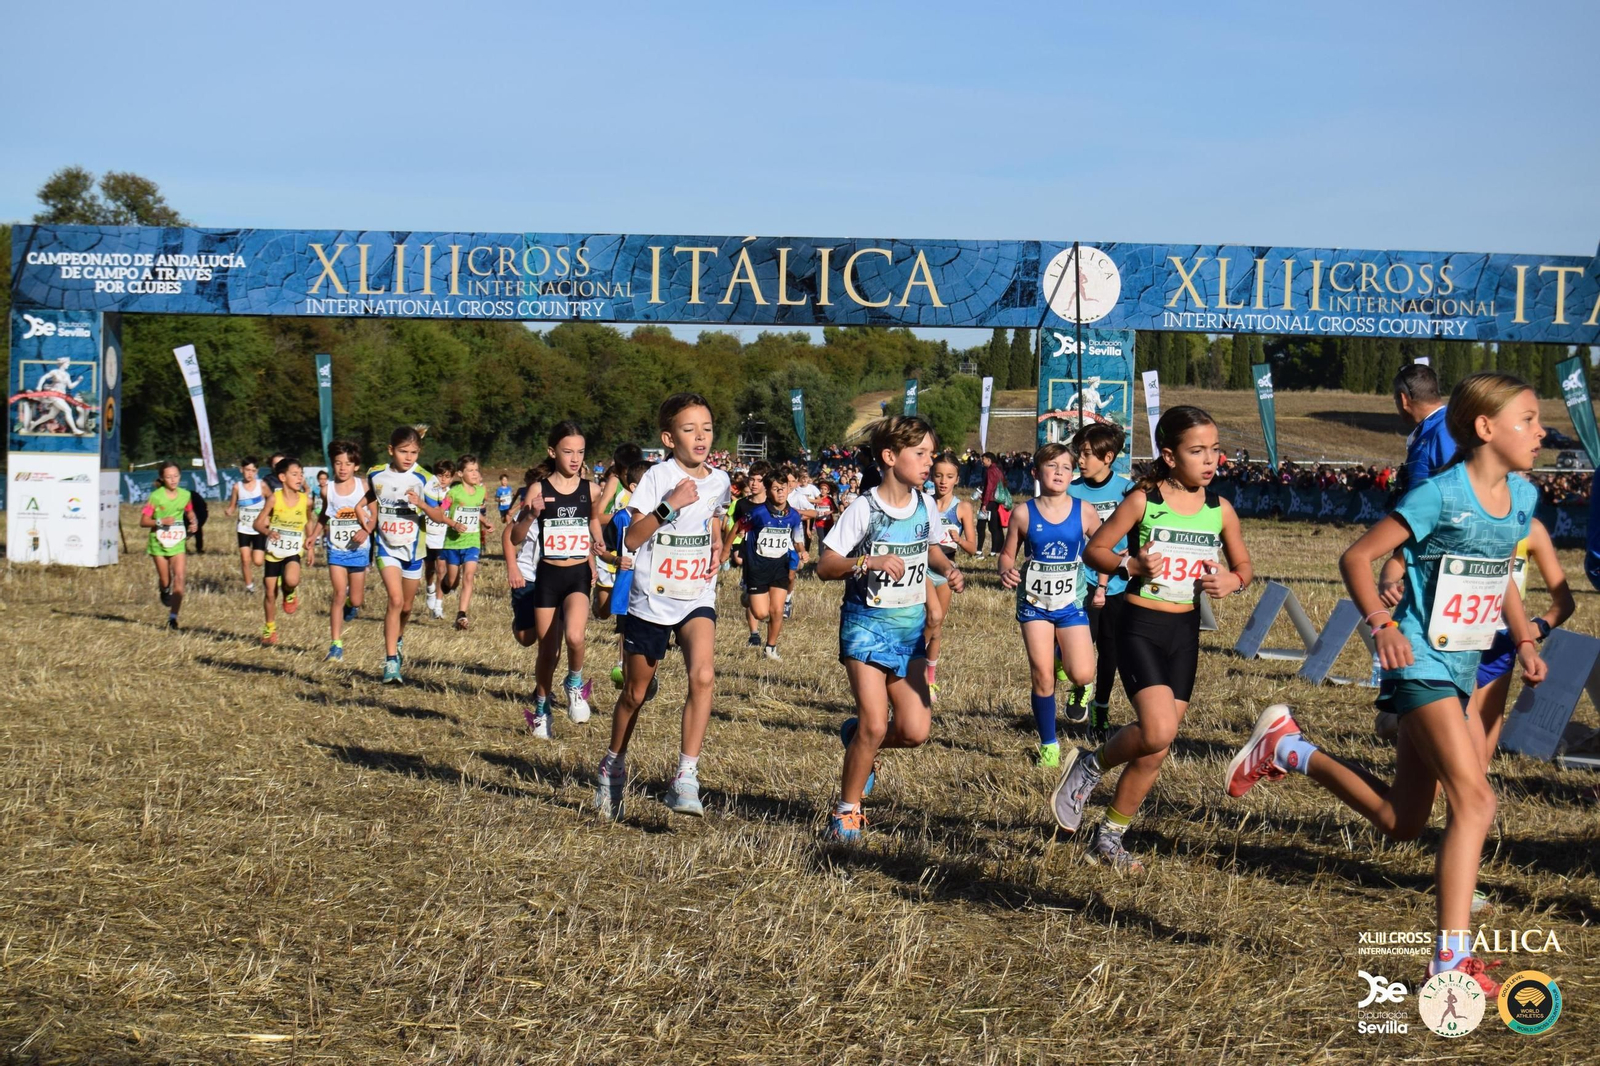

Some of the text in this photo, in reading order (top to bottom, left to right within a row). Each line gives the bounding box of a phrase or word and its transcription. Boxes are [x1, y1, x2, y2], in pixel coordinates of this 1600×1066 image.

[26, 251, 246, 268] CAMPEONATO DE ANDALUCÍA
[467, 246, 590, 277] CROSS
[61, 265, 82, 279] DE
[83, 266, 139, 280] CAMPO
[141, 267, 152, 280] A
[306, 243, 463, 296] XLIII
[647, 235, 948, 308] ITÁLICA
[1167, 256, 1326, 311] XLIII
[1329, 262, 1454, 295] CROSS
[94, 280, 182, 294] POR CLUBES
[468, 280, 636, 298] INTERNACIONAL
[306, 298, 605, 318] INTERNATIONAL CROSS COUNTRY
[1328, 296, 1500, 317] INTERNACIONAL
[1163, 312, 1468, 336] INTERNATIONAL CROSS COUNTRY
[57, 328, 91, 337] Sevilla
[1088, 346, 1122, 356] Sevilla
[456, 515, 478, 525] 4172
[557, 506, 577, 518] CV
[160, 531, 184, 540] 4427
[382, 521, 414, 535] 4453
[545, 534, 590, 551] 4375
[675, 537, 704, 545] ITÁLICA
[760, 537, 788, 549] 4116
[1175, 532, 1209, 544] ITÁLICA
[893, 546, 920, 555] ITÁLICA
[1042, 564, 1068, 572] ITÁLICA
[1161, 557, 1204, 582] 434
[1469, 562, 1504, 575] ITÁLICA
[1031, 578, 1073, 596] 4195
[1442, 593, 1503, 625] 4379
